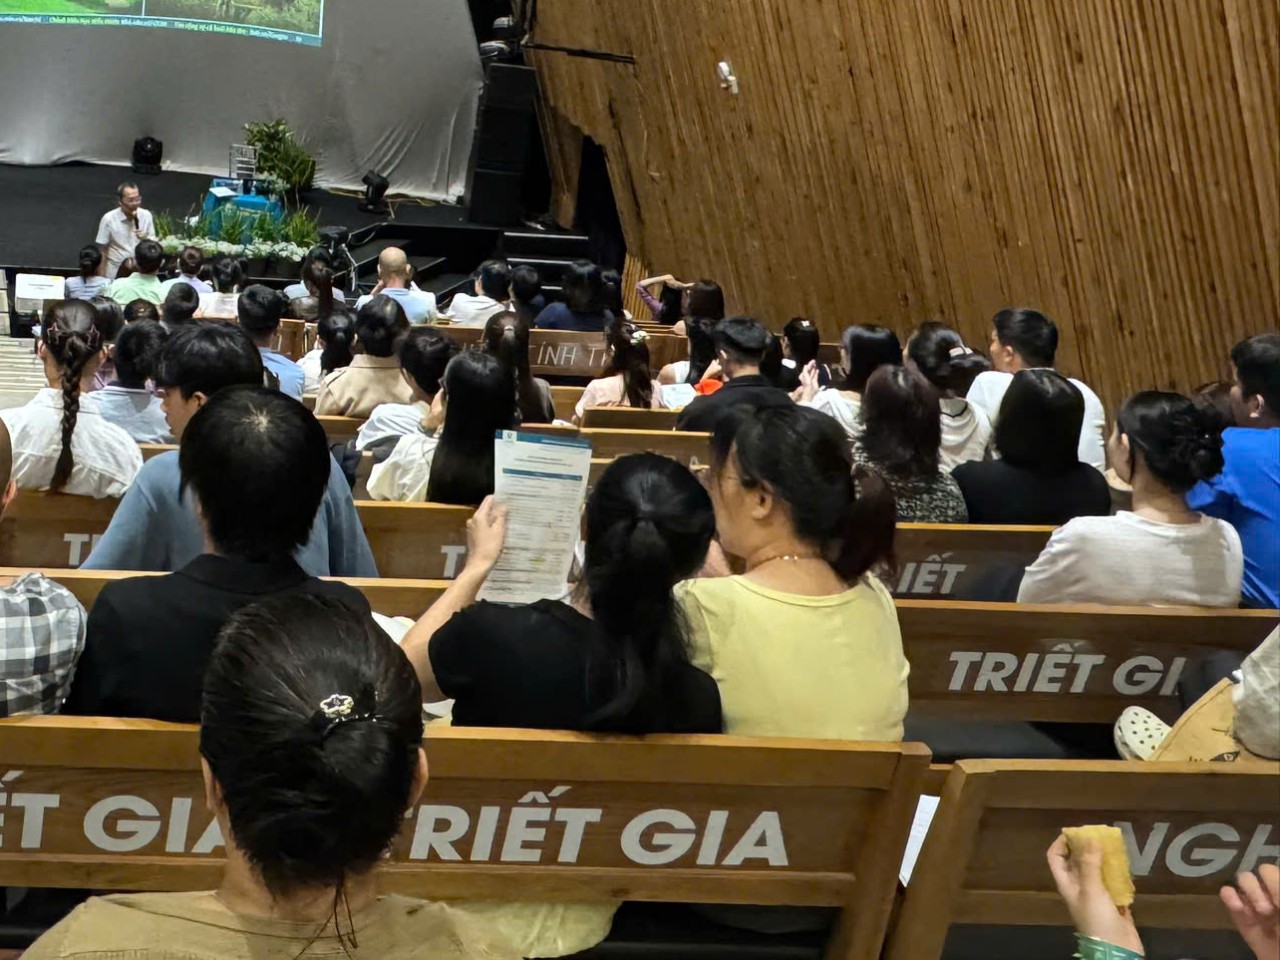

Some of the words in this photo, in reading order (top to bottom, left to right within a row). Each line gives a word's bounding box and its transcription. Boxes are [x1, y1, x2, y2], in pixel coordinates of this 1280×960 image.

[948, 638, 1107, 694] TRIẾT
[1112, 655, 1188, 697] GI
[404, 785, 603, 863] RIẾT
[620, 808, 789, 867] GIA
